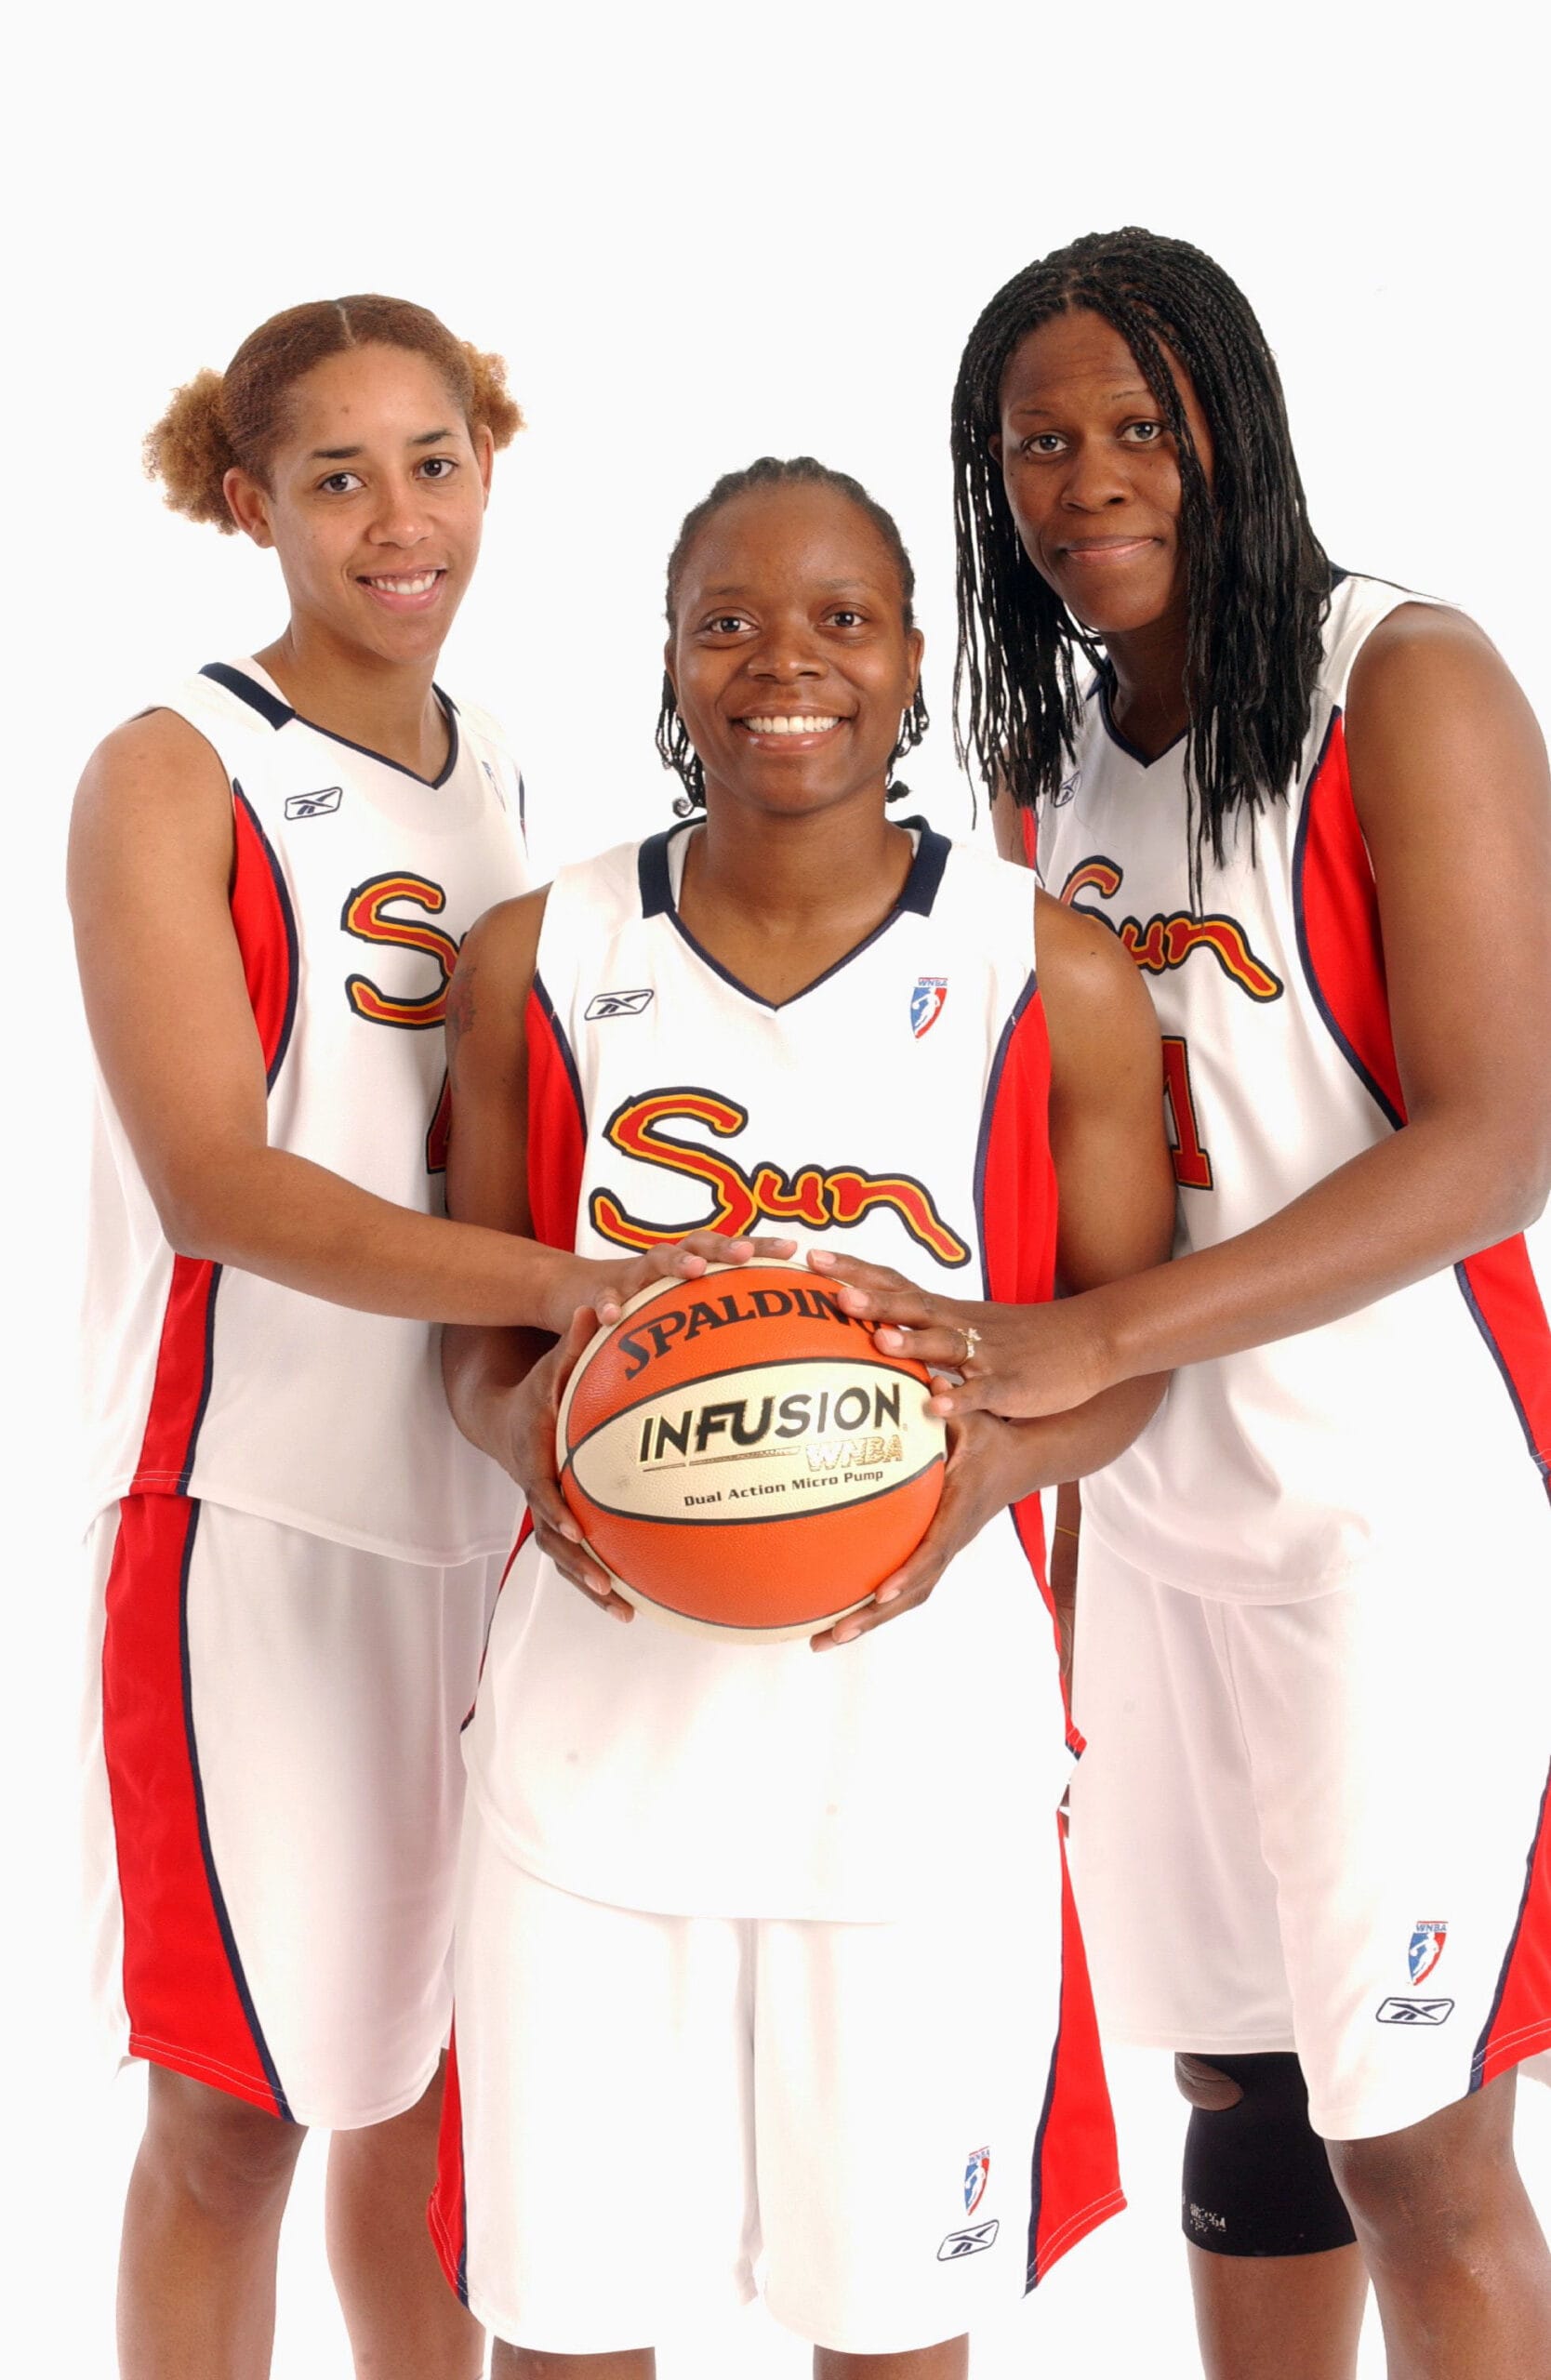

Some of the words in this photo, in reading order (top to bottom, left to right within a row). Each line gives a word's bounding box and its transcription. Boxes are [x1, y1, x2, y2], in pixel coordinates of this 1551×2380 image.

[589, 1086, 972, 1269] Sun
[617, 1288, 882, 1381] SPALDIN
[639, 1382, 901, 1463] INFUSION
[805, 1435, 904, 1472] WNBA
[684, 1491, 722, 1507] Dual
[728, 1483, 786, 1501] Action
[791, 1475, 839, 1490] Micro
[843, 1470, 884, 1485] Pump
[1415, 1924, 1447, 1932] WNBA
